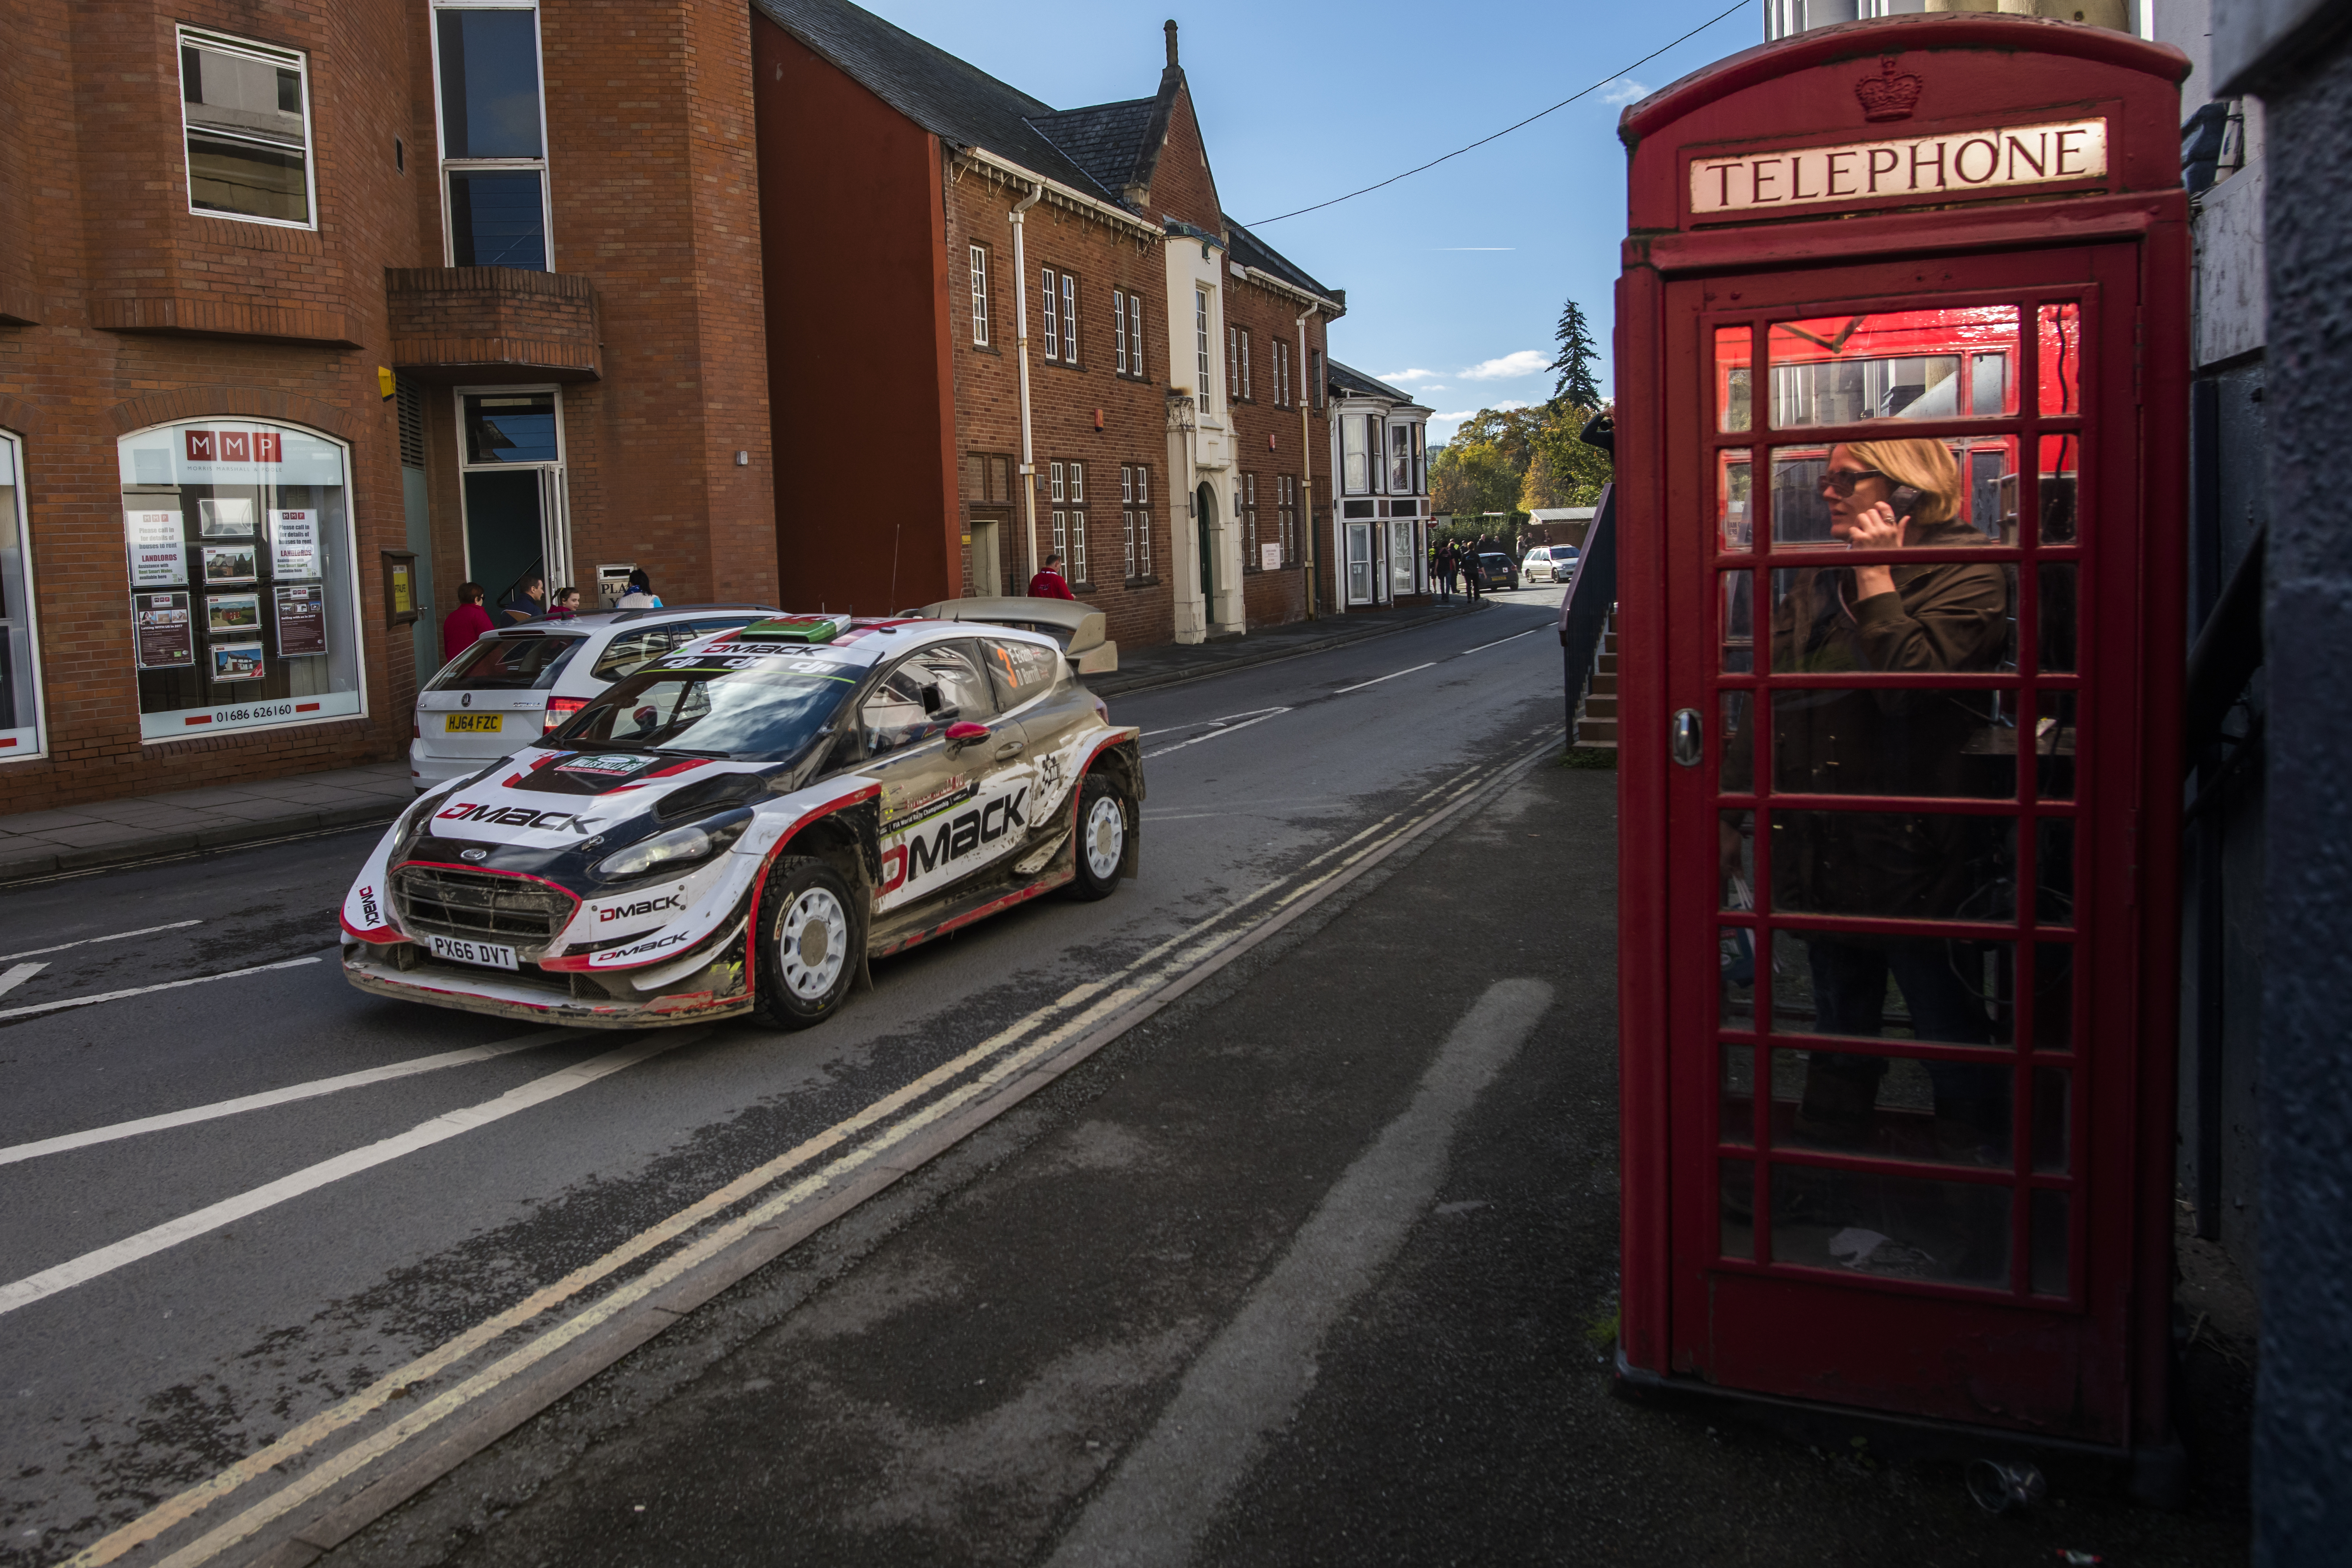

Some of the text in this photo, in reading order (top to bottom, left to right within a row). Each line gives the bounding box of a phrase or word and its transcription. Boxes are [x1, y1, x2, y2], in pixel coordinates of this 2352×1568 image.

[1706, 129, 2088, 206] TELEPHONE
[601, 583, 627, 594] PLA
[1008, 647, 1033, 665] E Evans
[997, 648, 1017, 688] 3
[1015, 669, 1024, 686] D
[217, 704, 291, 722] 01686 626160
[449, 716, 498, 730] HJ64 FZC
[569, 758, 644, 771] WALES RALLY GB
[901, 817, 912, 826] World
[913, 812, 923, 823] Rally
[923, 800, 949, 816] Championship
[435, 938, 509, 965] PX66 DVT
